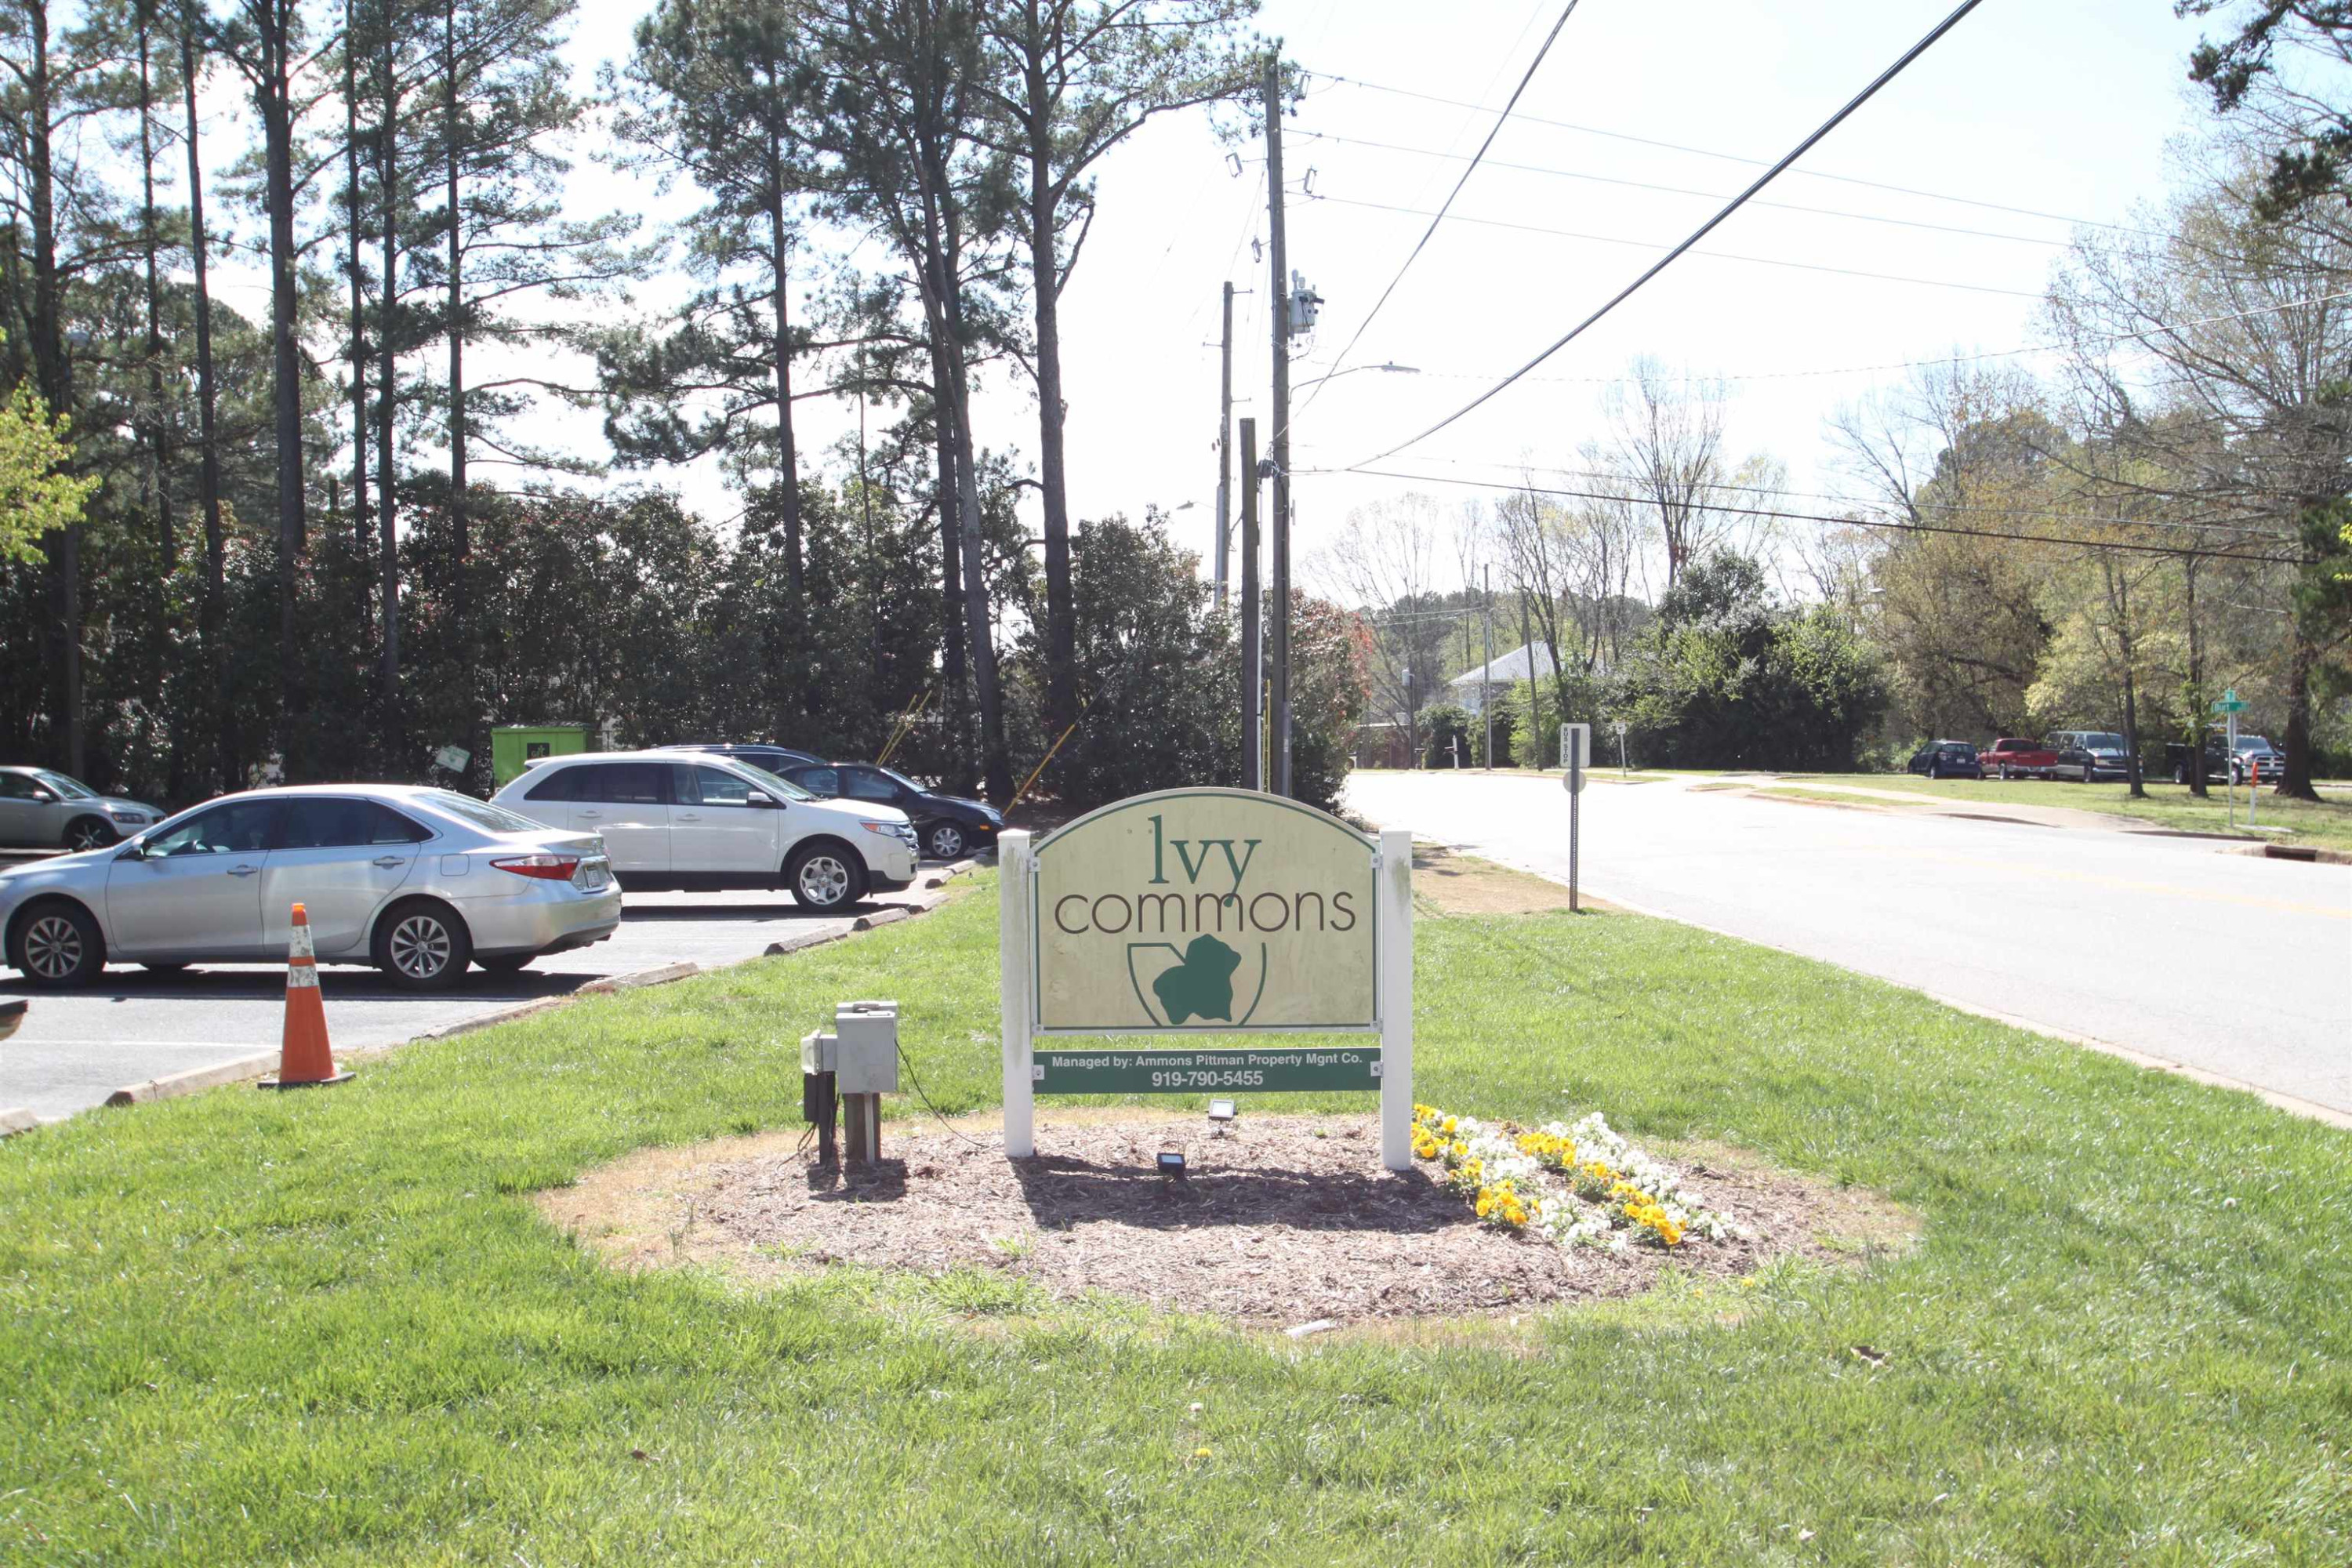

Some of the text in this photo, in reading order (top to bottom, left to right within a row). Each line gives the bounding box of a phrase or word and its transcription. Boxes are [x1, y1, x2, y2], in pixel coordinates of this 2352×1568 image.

[1054, 891, 1356, 935] commons
[1051, 1053, 1363, 1069] Managed by: Ammons Pittman Property Mgnt Co.
[1152, 1070, 1264, 1087] 919-790-5455
